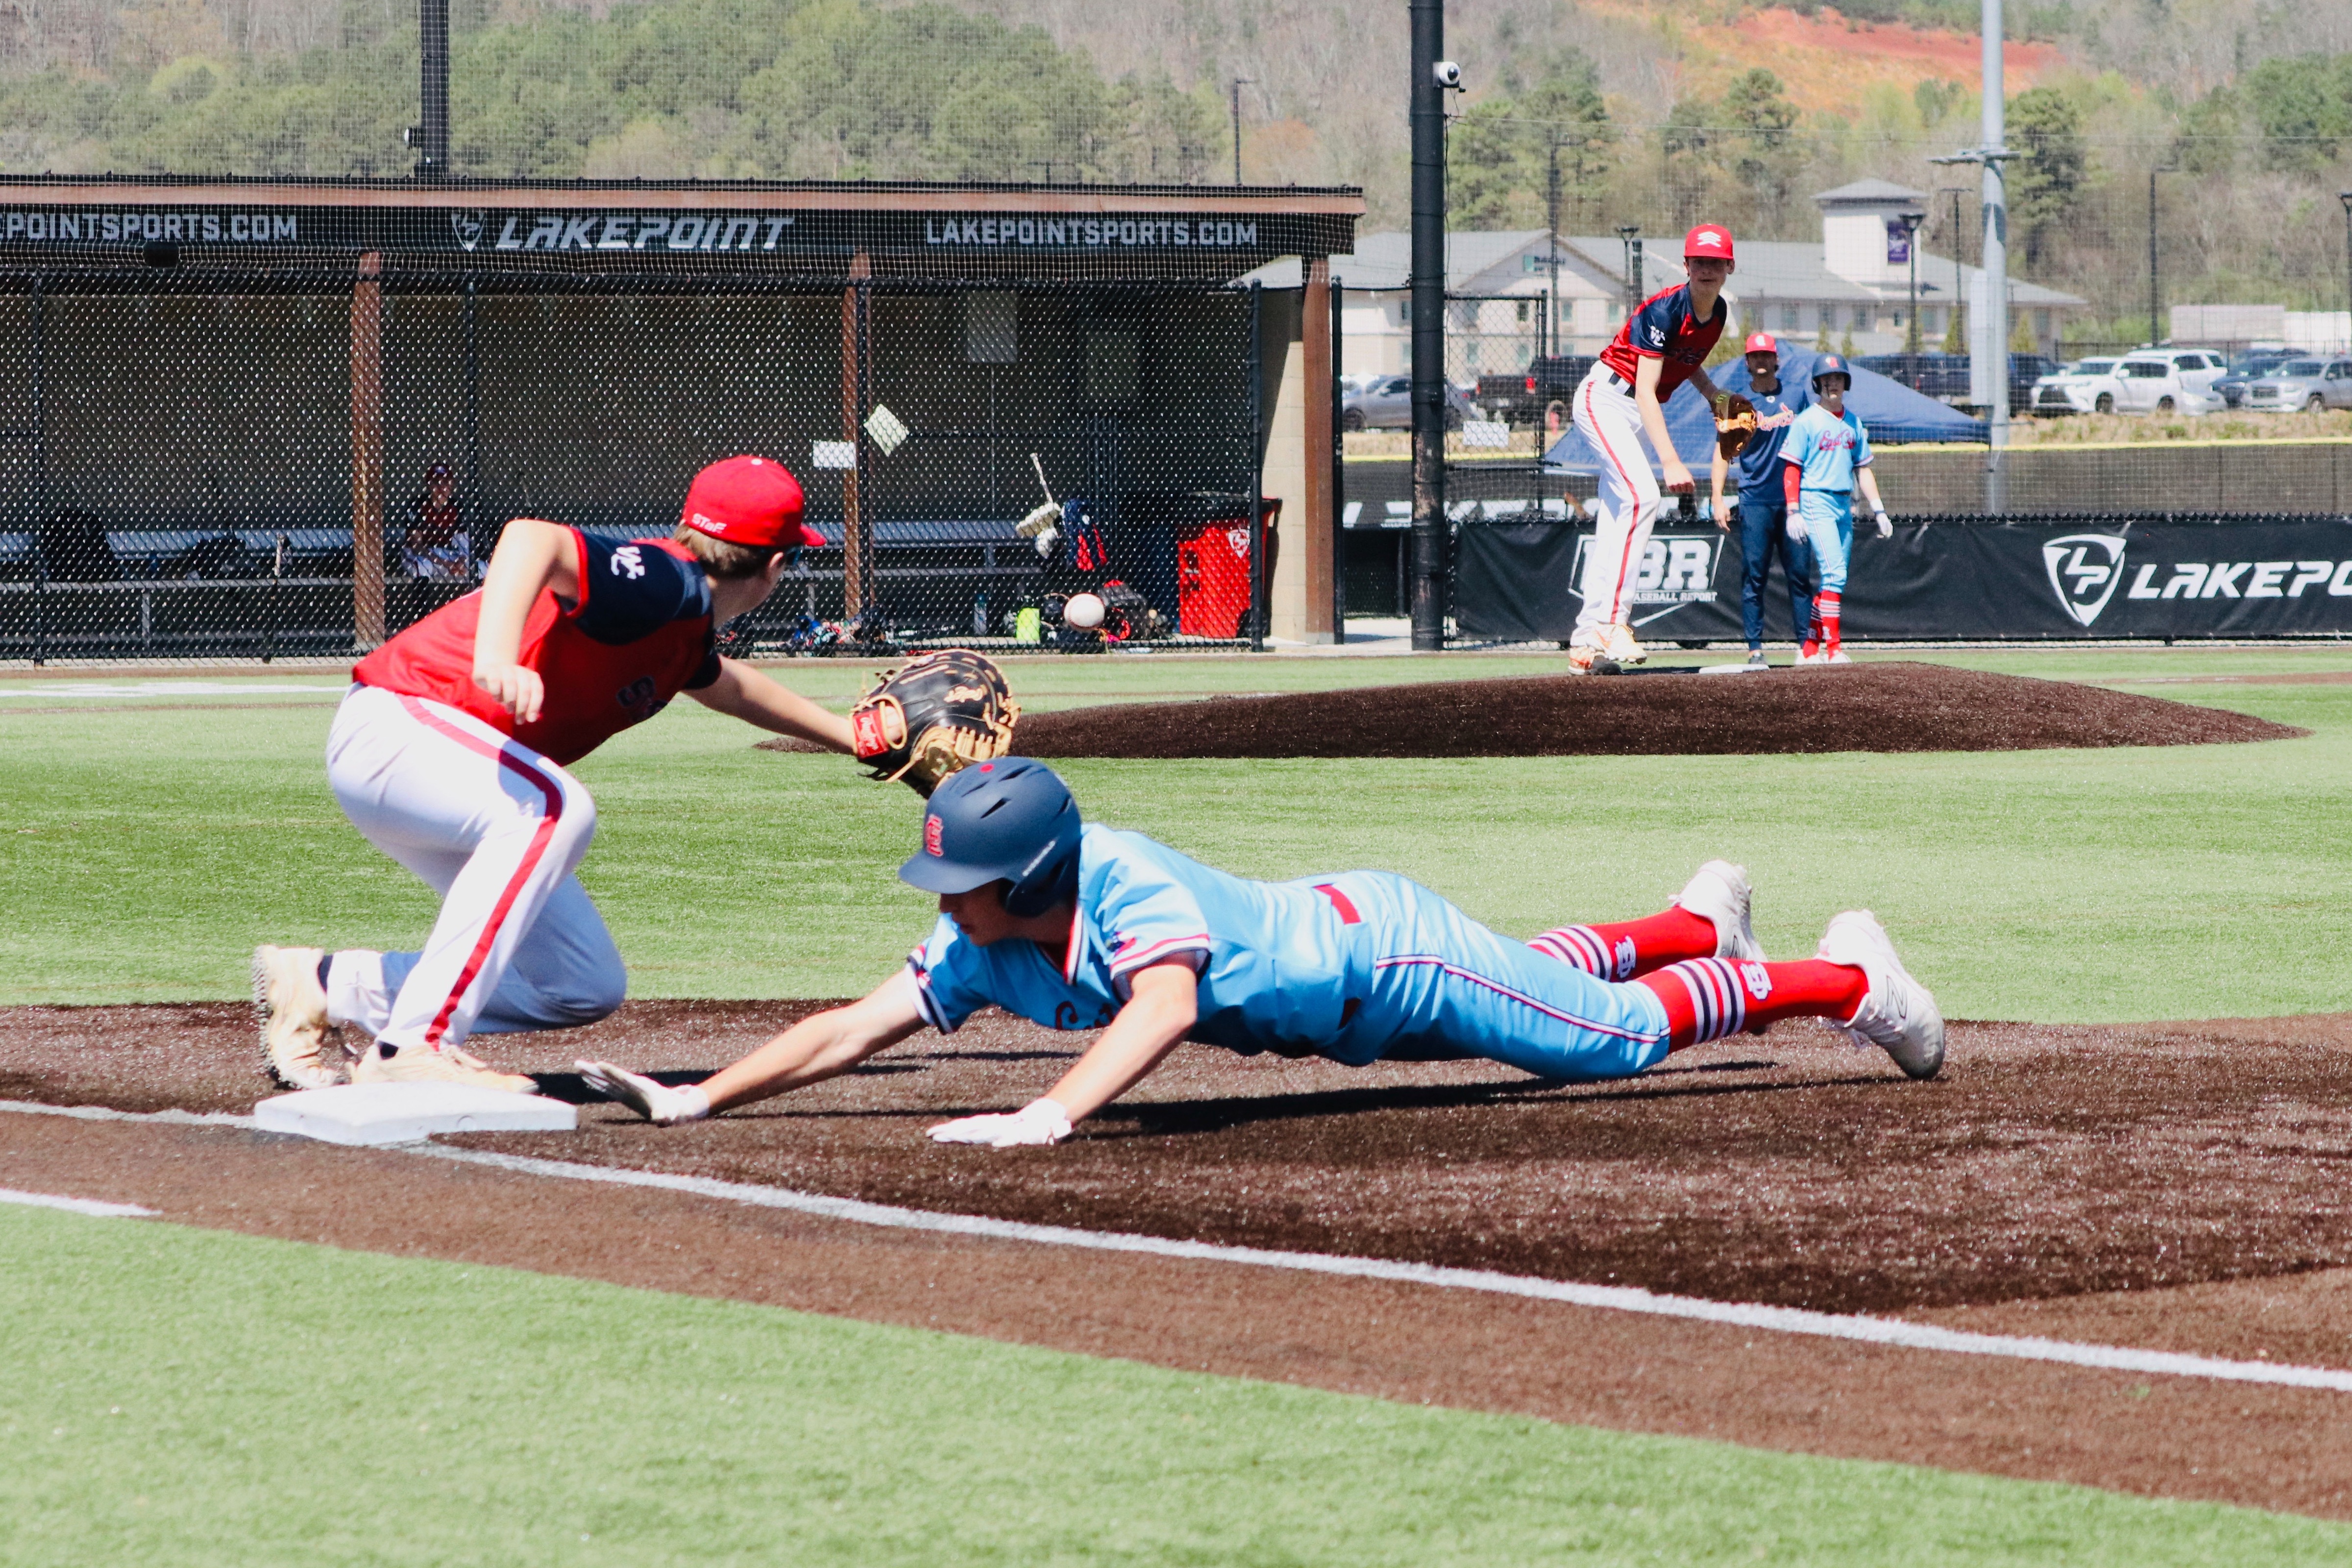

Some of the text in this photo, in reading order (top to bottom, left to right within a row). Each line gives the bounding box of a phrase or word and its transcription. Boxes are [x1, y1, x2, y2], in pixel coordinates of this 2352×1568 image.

[0, 213, 296, 240] POINTSPORTS.COM
[495, 216, 795, 250] LAKEPOINT
[926, 219, 1257, 245] LAKEPOINTSPORTS.COM
[1580, 540, 1711, 590] BR
[1633, 591, 1718, 602] ASEBALL REPORT
